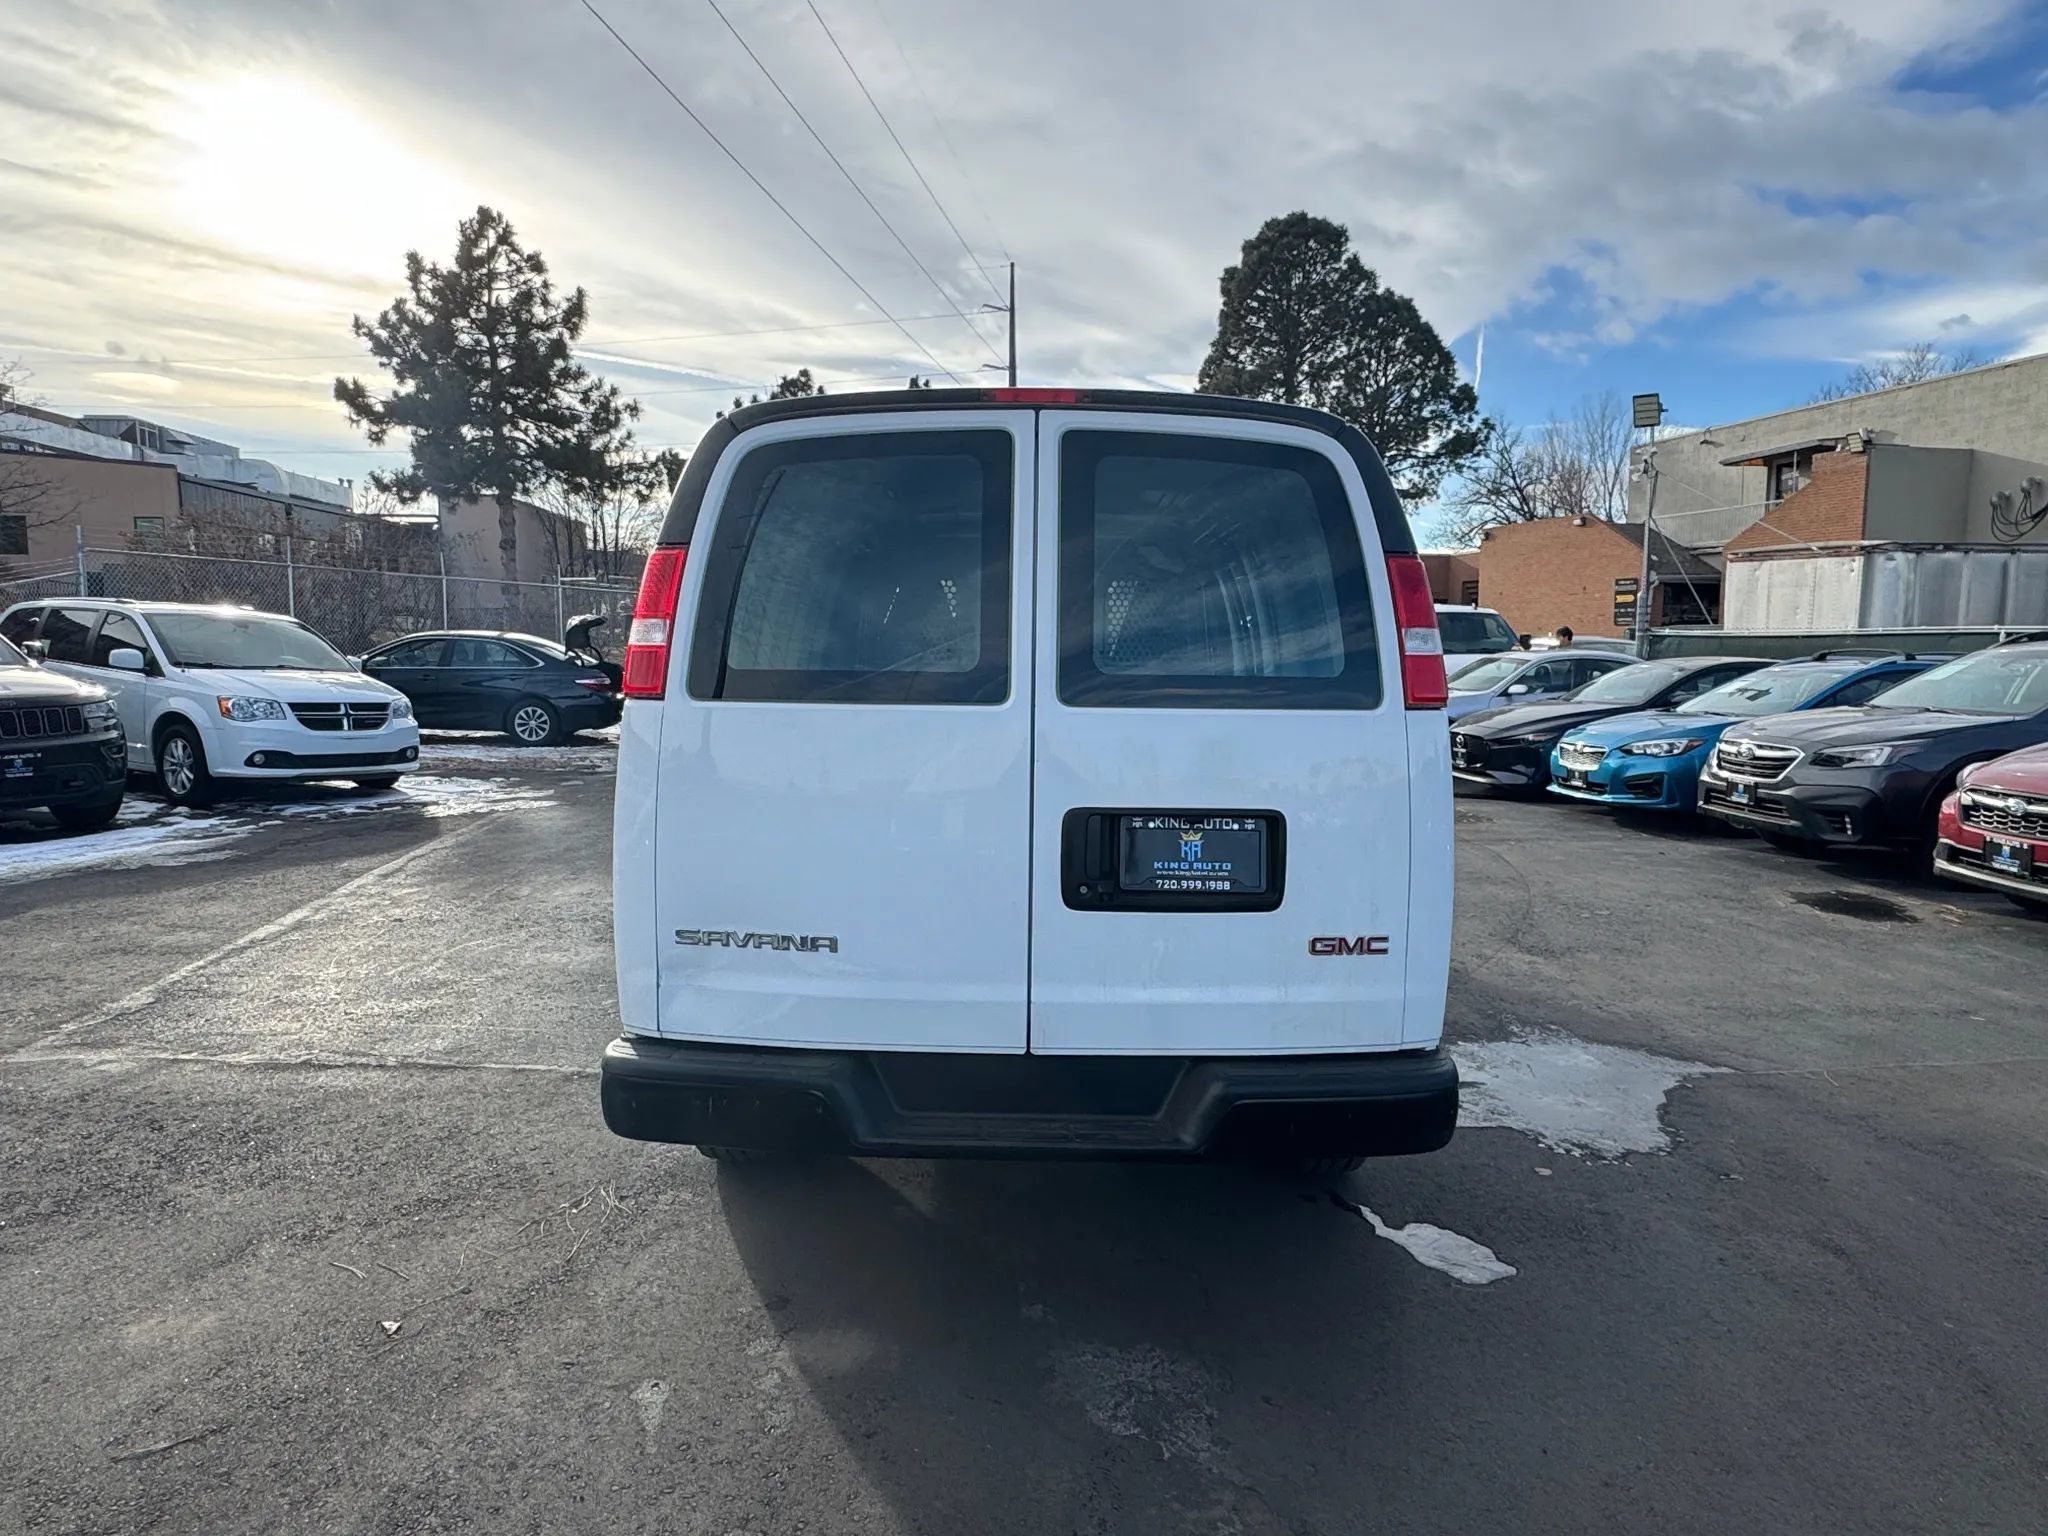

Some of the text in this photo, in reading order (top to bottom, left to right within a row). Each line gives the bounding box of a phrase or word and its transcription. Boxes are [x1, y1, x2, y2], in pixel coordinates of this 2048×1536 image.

[1153, 861, 1232, 871] KING AUTO
[1155, 879, 1231, 891] 720.999.1988
[674, 928, 839, 954] SAVANA
[1308, 935, 1390, 956] GMC
